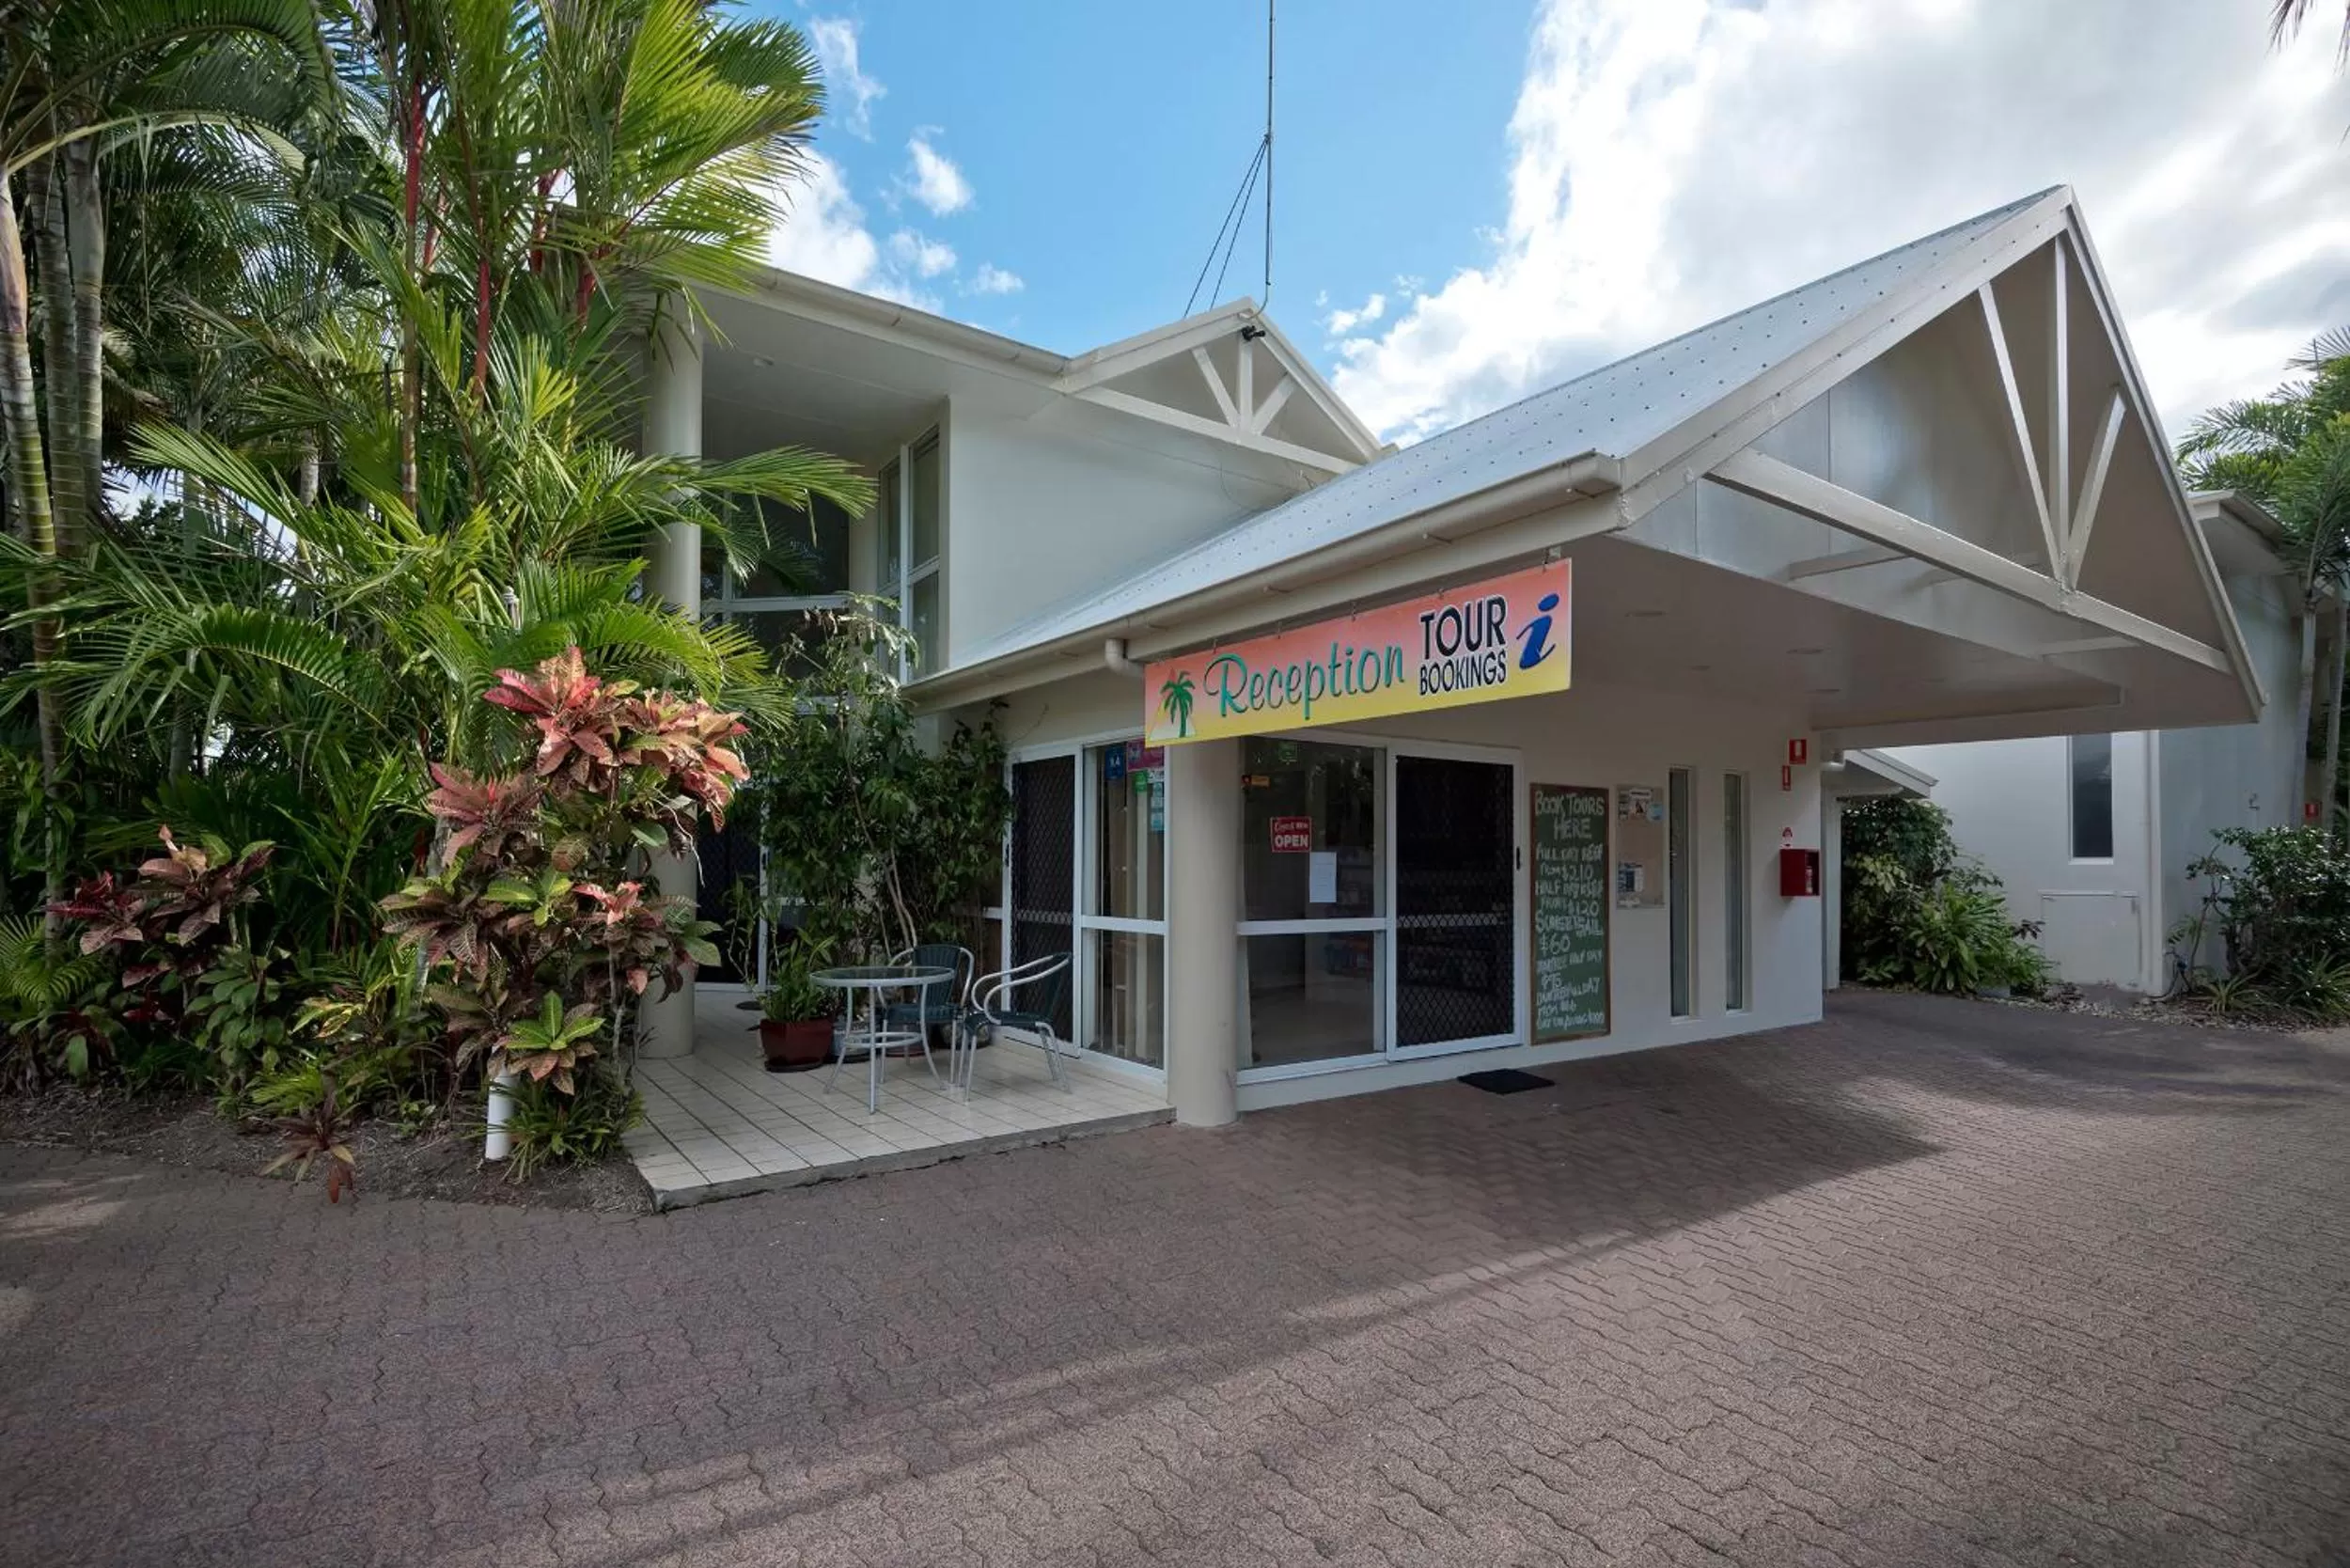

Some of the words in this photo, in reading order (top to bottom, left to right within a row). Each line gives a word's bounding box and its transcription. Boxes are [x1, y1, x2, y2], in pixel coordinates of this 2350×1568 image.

[1419, 595, 1507, 660] TOUR
[1204, 642, 1404, 720] Reception
[1419, 651, 1507, 696] BOOKINGS
[1554, 815, 1592, 839] HERE
[1275, 834, 1308, 849] OPEN
[1535, 879, 1561, 896] HALF
[1541, 931, 1571, 957] $60
